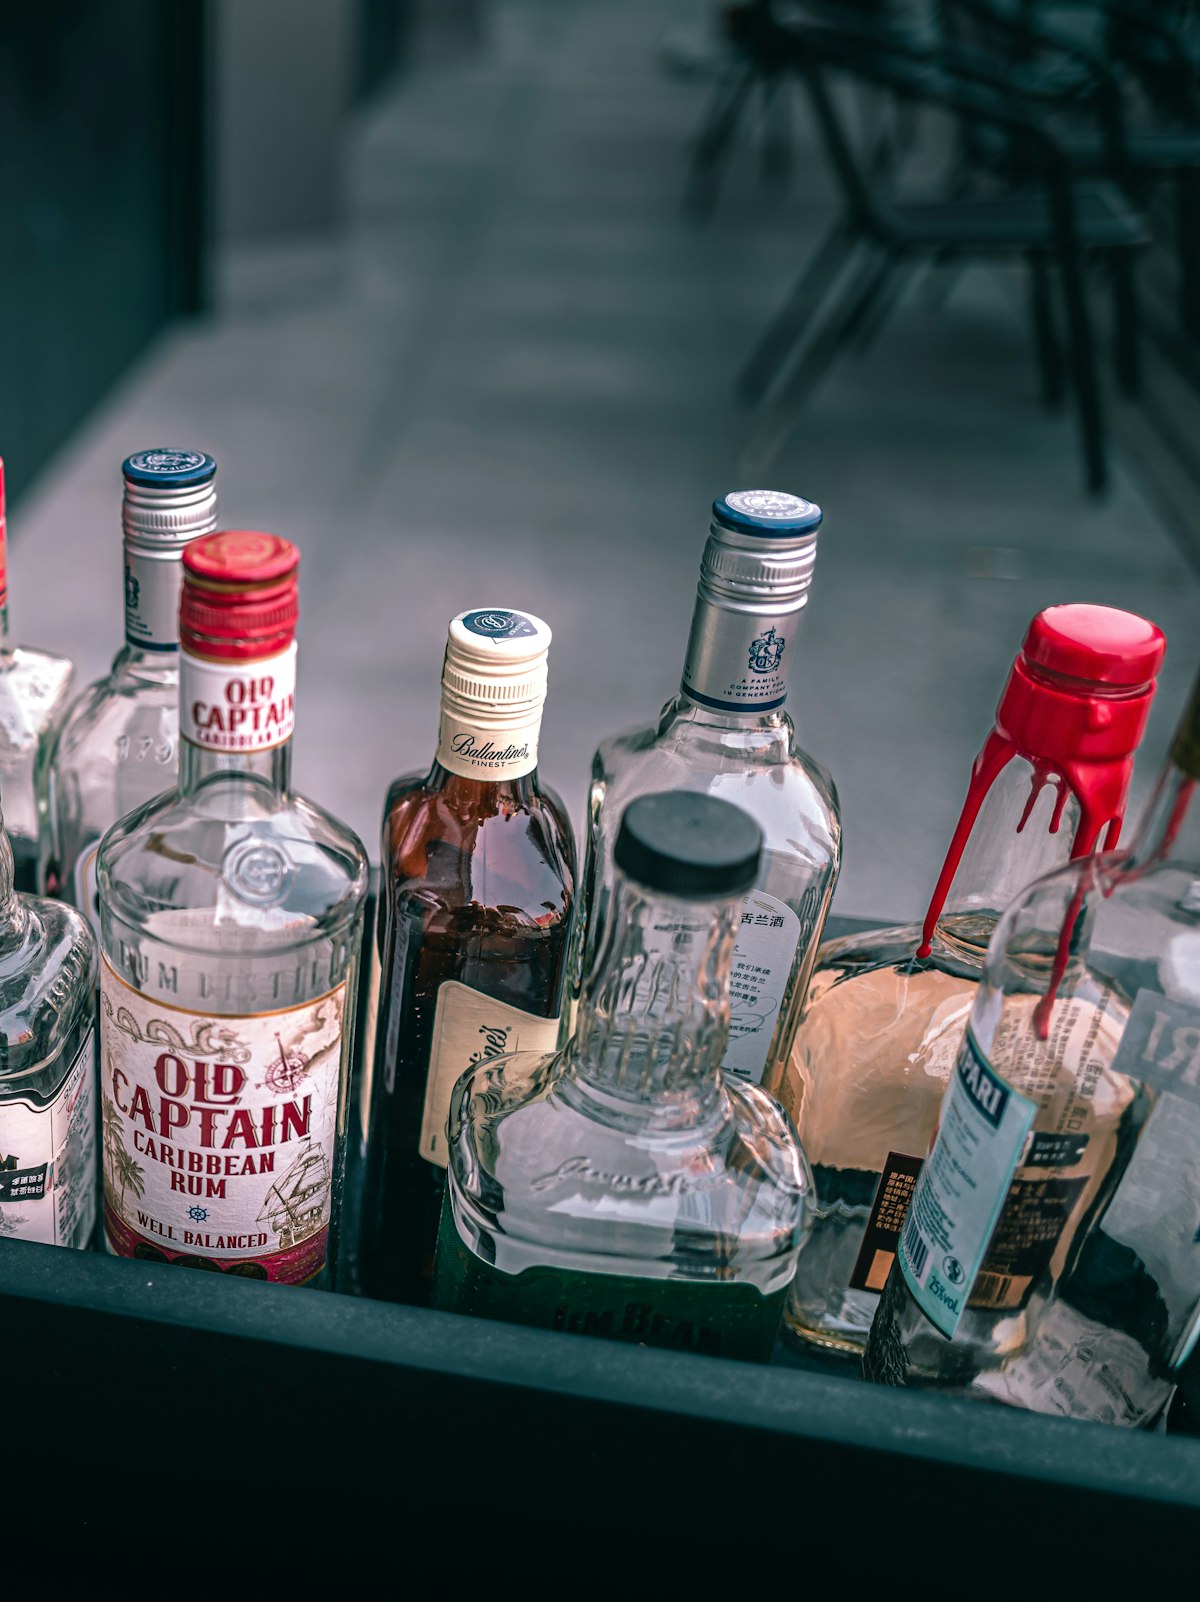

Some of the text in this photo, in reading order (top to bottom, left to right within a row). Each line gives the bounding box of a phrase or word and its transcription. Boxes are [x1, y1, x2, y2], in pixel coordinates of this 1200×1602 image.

[751, 676, 780, 684] FAMILY
[471, 759, 507, 768] FINEST
[154, 1053, 248, 1105] OLD
[112, 1068, 312, 1149] CAPTAIN
[133, 1129, 276, 1176] CARIBBEAN
[171, 1170, 227, 1199] RUM
[137, 1210, 268, 1249] WELL BALANCED
